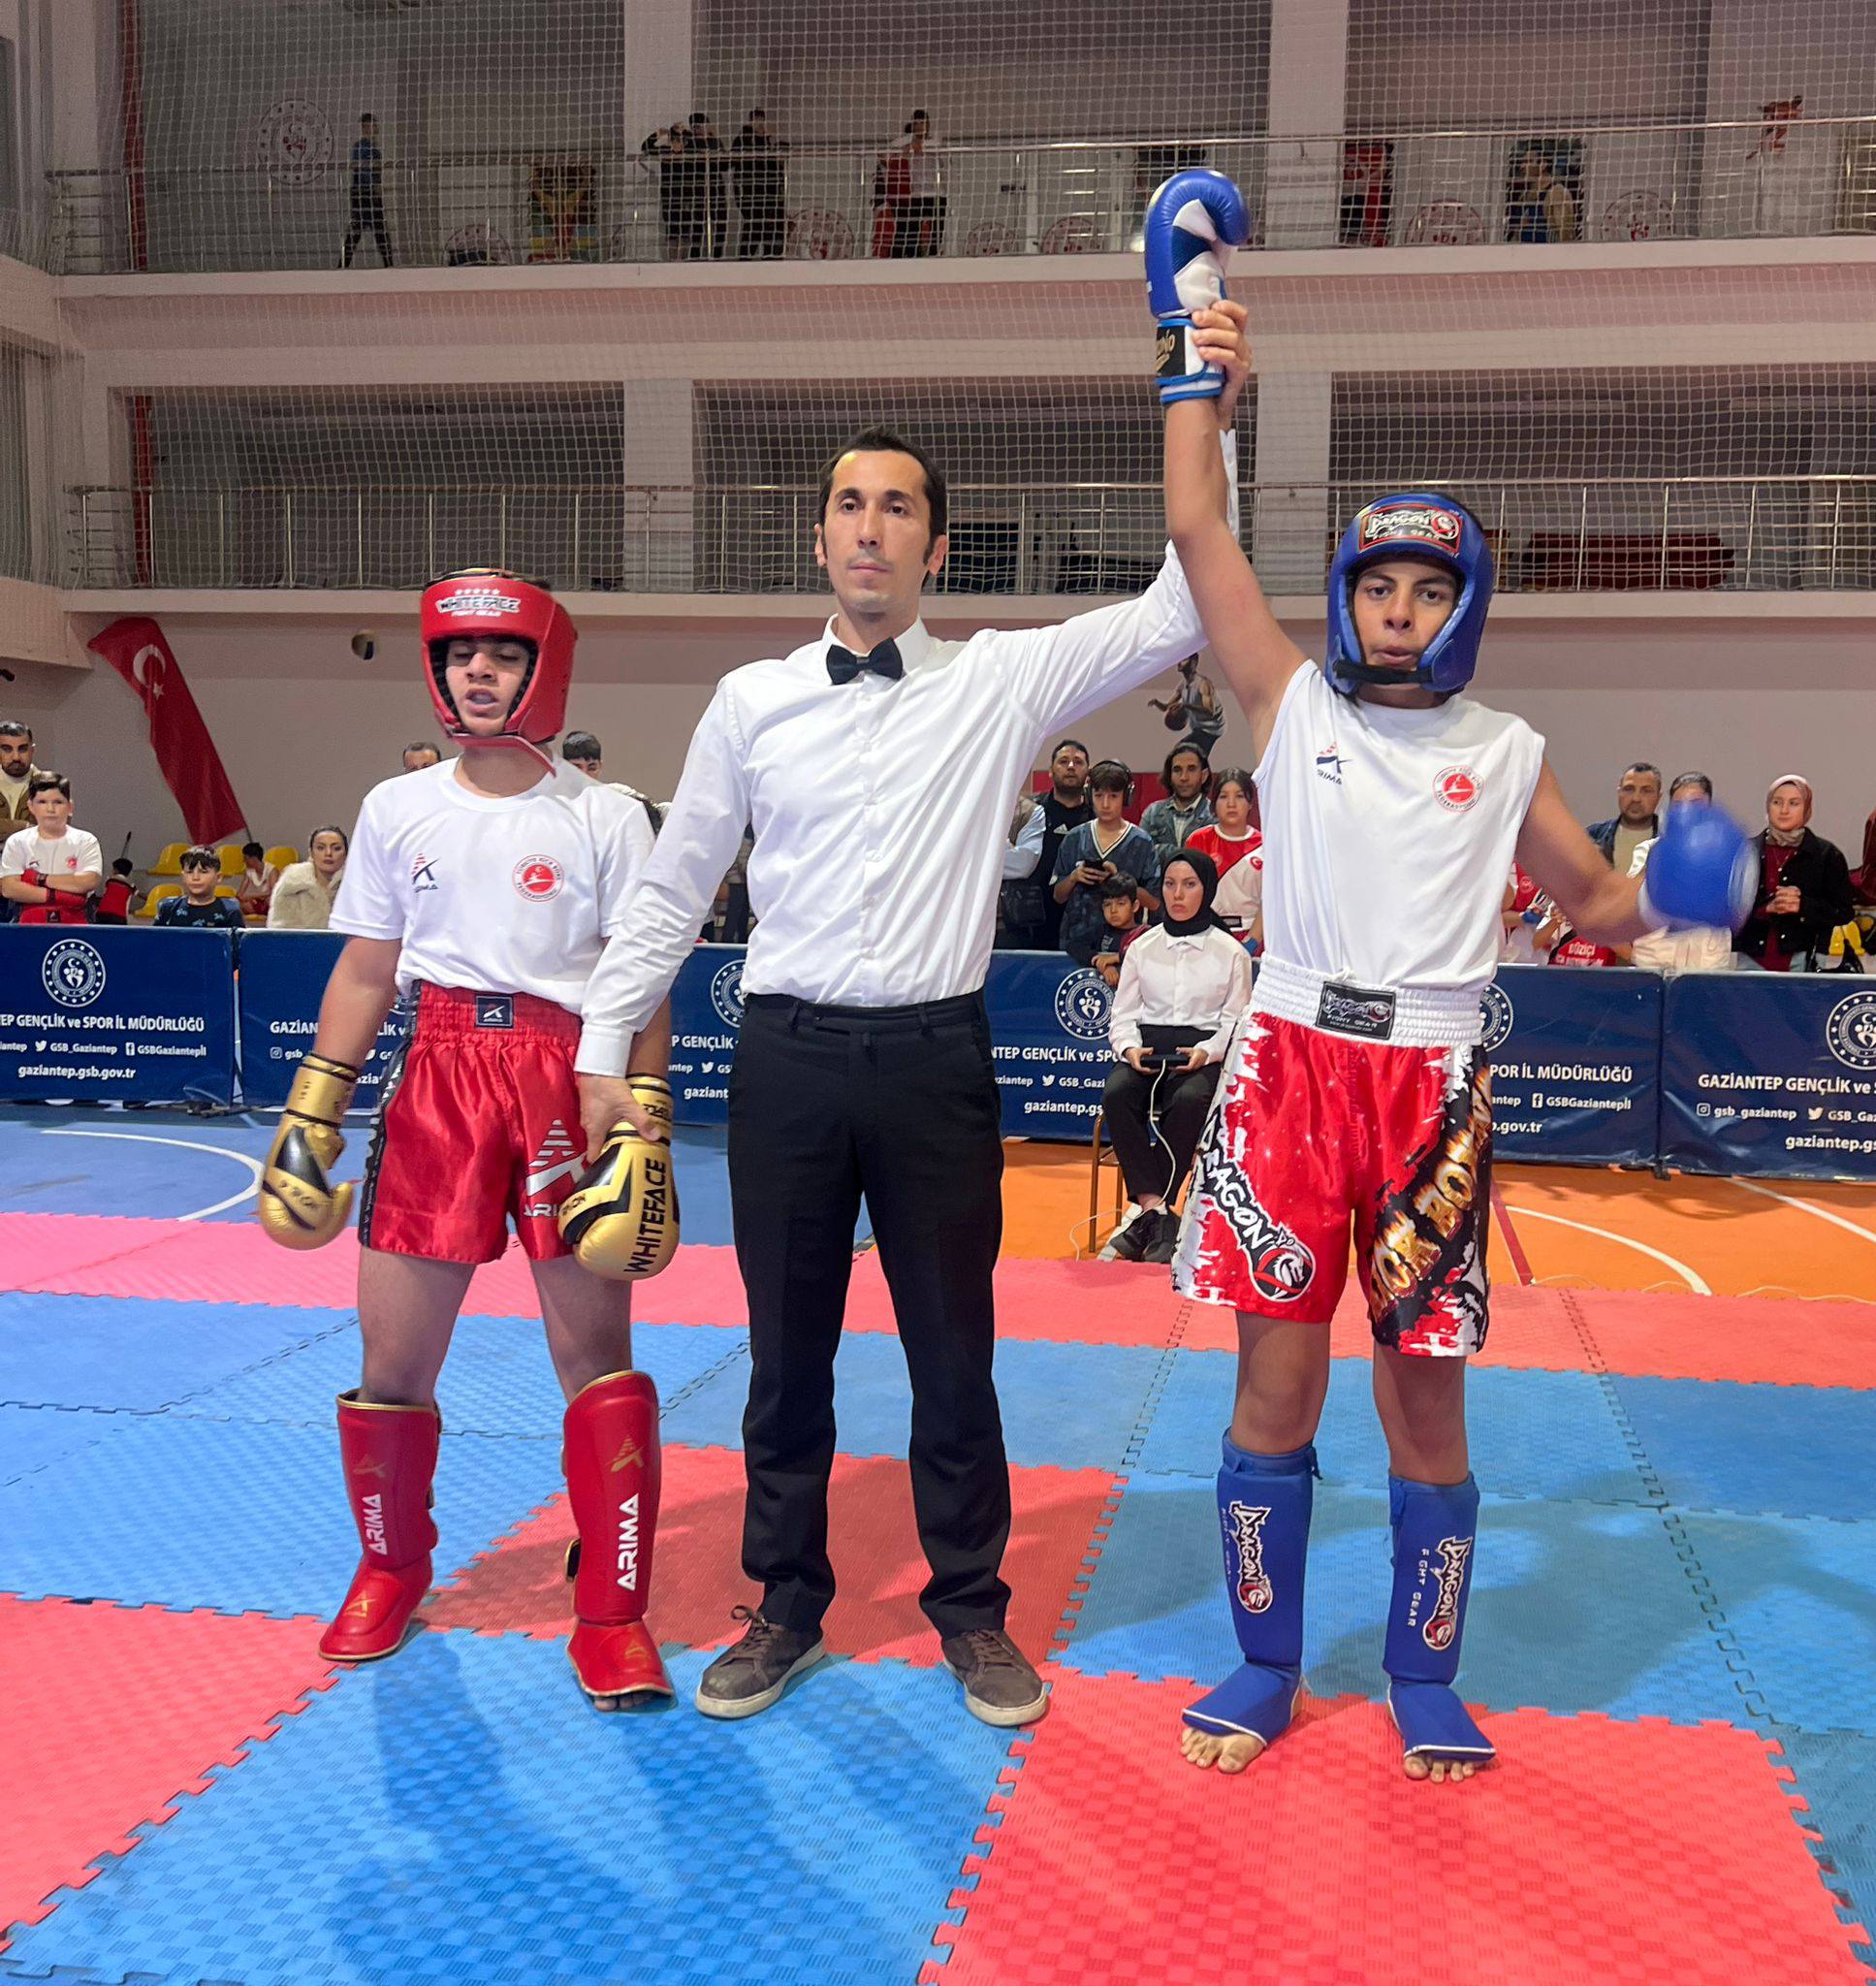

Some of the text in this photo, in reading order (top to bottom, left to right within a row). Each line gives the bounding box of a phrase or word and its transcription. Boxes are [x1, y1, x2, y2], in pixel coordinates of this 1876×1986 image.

[16, 1013, 65, 1030] GENÇLİK
[67, 1018, 81, 1029] ve
[82, 1015, 113, 1030] SPOR
[115, 1014, 126, 1030] İL
[128, 1016, 206, 1033] MÜDÜRLÜĞÜ
[49, 1042, 117, 1055] GSB_Gaziantep
[682, 1034, 734, 1051] GENÇLİK
[1022, 1045, 1077, 1064] GENÇLİK
[1078, 1051, 1095, 1062] ve
[17, 1064, 137, 1080] gaziantep.gsb.gov.tr
[1521, 1062, 1535, 1078] İL
[1537, 1064, 1634, 1083] MÜDÜRLÜĞÜ
[1698, 1072, 1784, 1091] GAZİANTEP
[1785, 1076, 1852, 1096] GENÇLİK
[1853, 1082, 1871, 1095] ve
[1713, 1105, 1797, 1121] gsb_gaziantep
[623, 1157, 668, 1273] WHITEFACE
[362, 1492, 388, 1556] ARIMA
[616, 1492, 640, 1592] ARIMA
